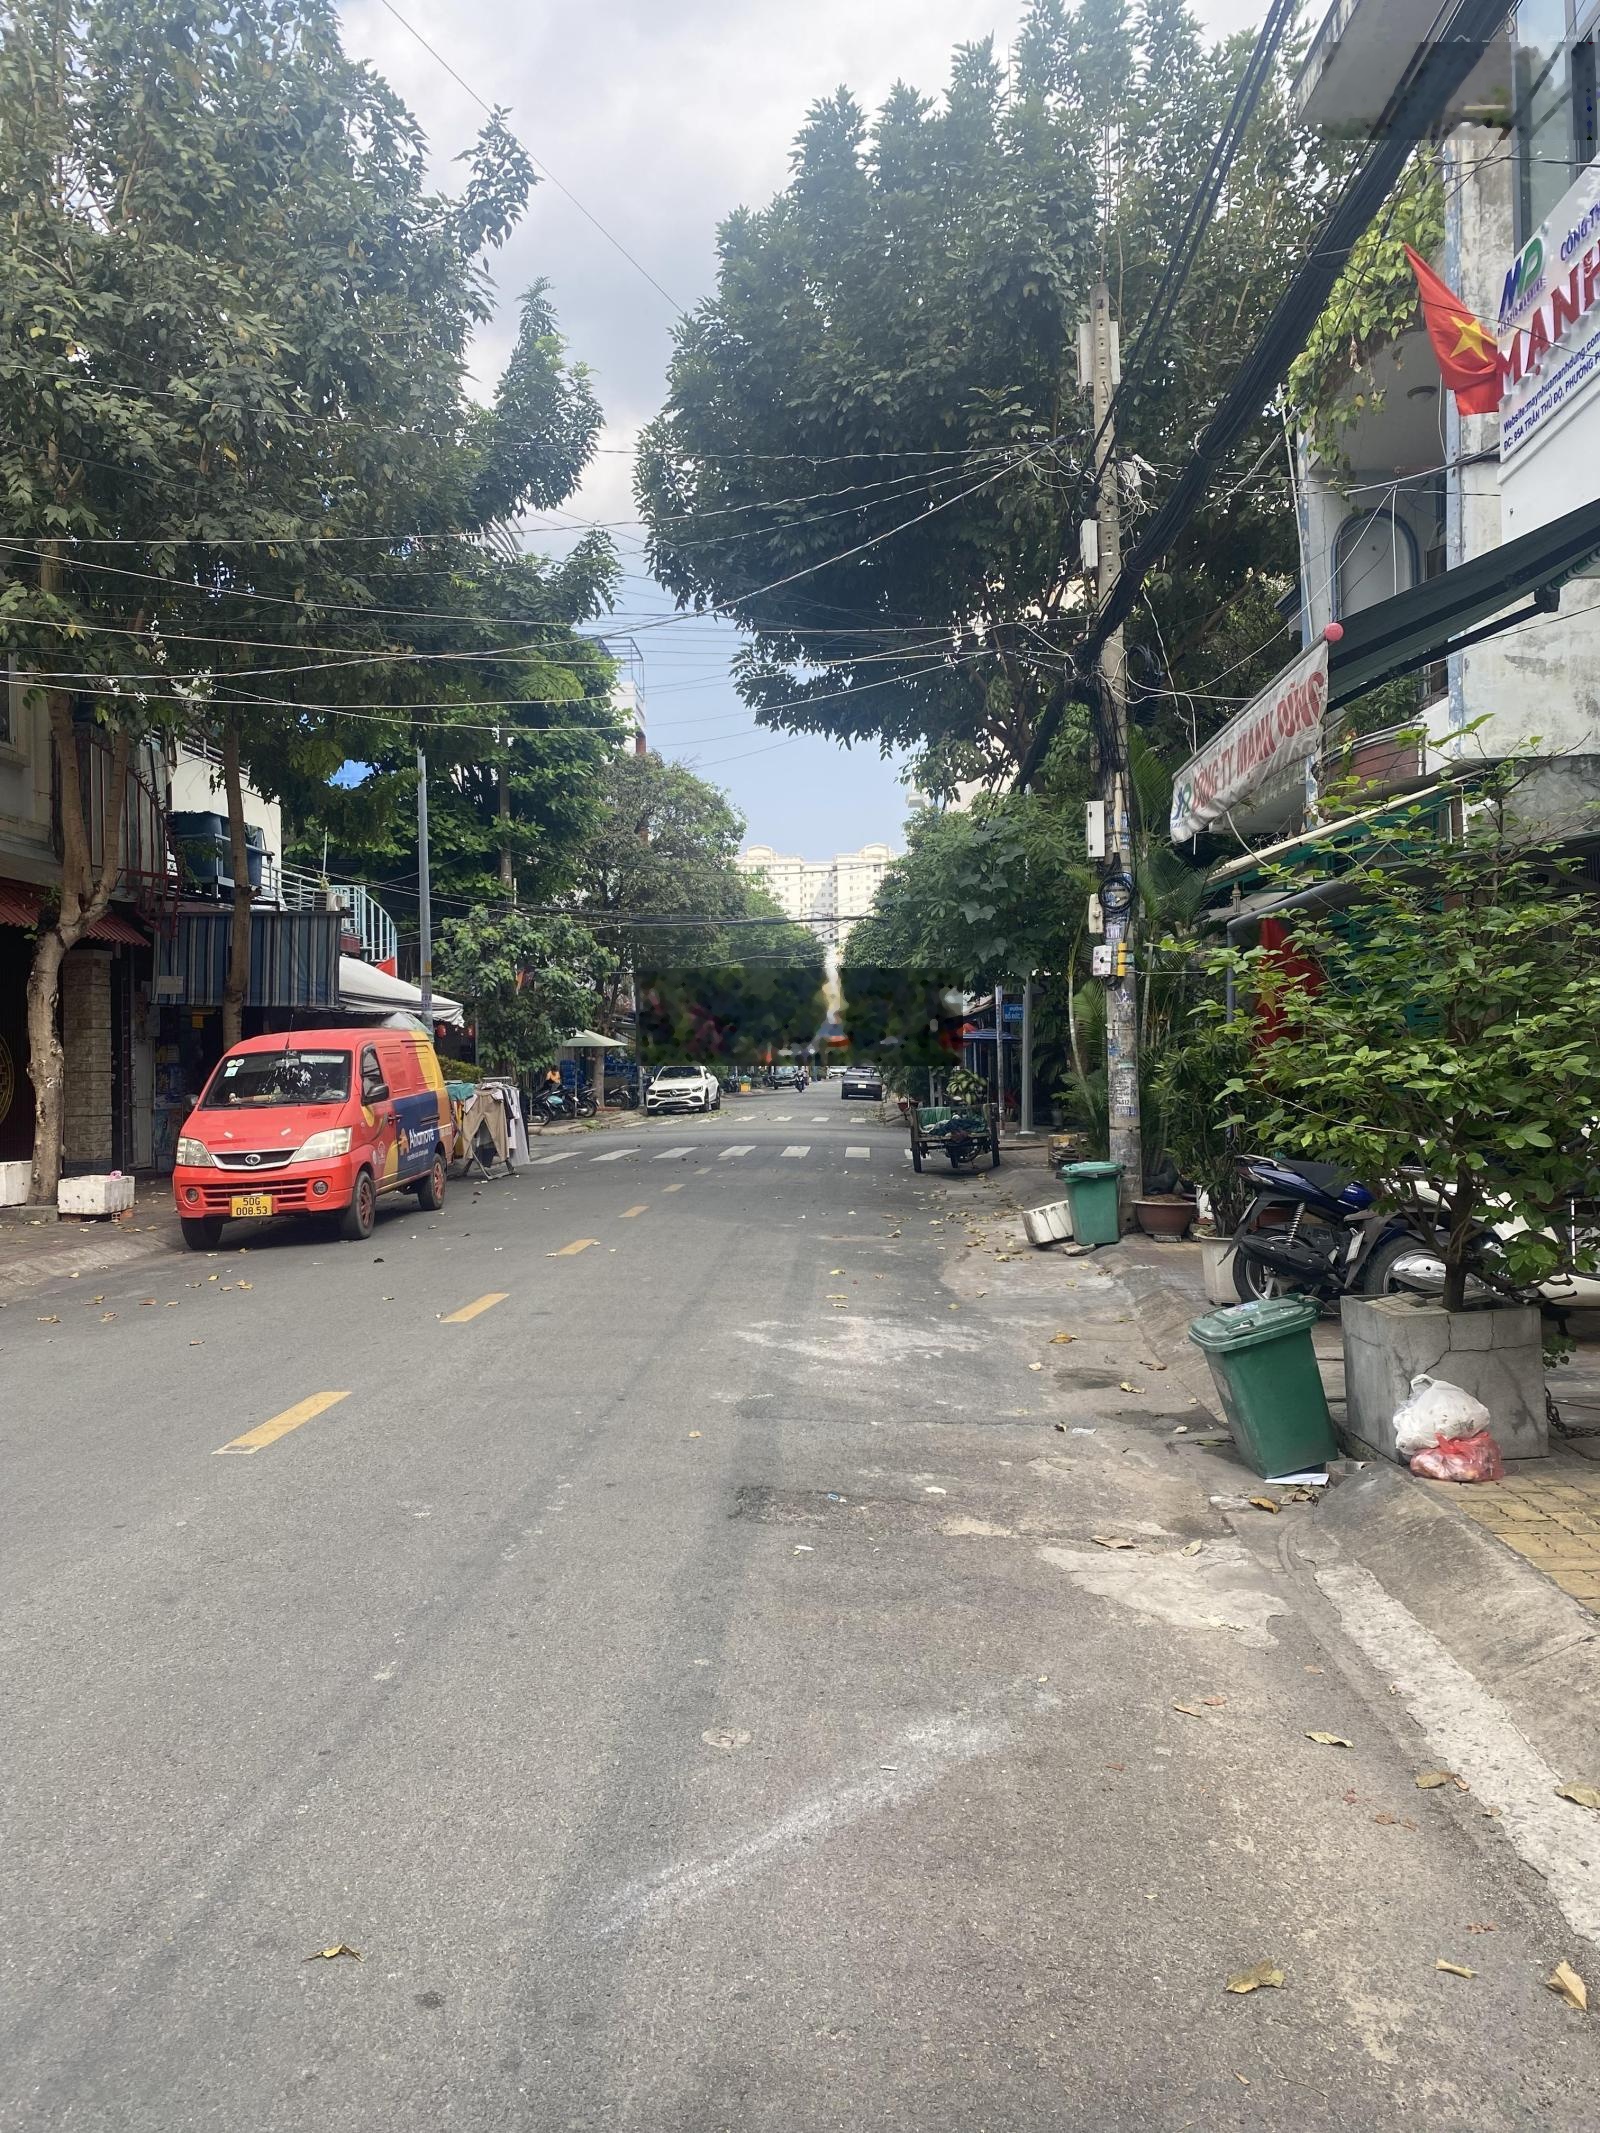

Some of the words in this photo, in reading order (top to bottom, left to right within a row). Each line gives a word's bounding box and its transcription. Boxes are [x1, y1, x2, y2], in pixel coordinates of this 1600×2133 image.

[1221, 744, 1235, 790] TY
[242, 1197, 261, 1206] 50G
[236, 1206, 268, 1216] 008.53
